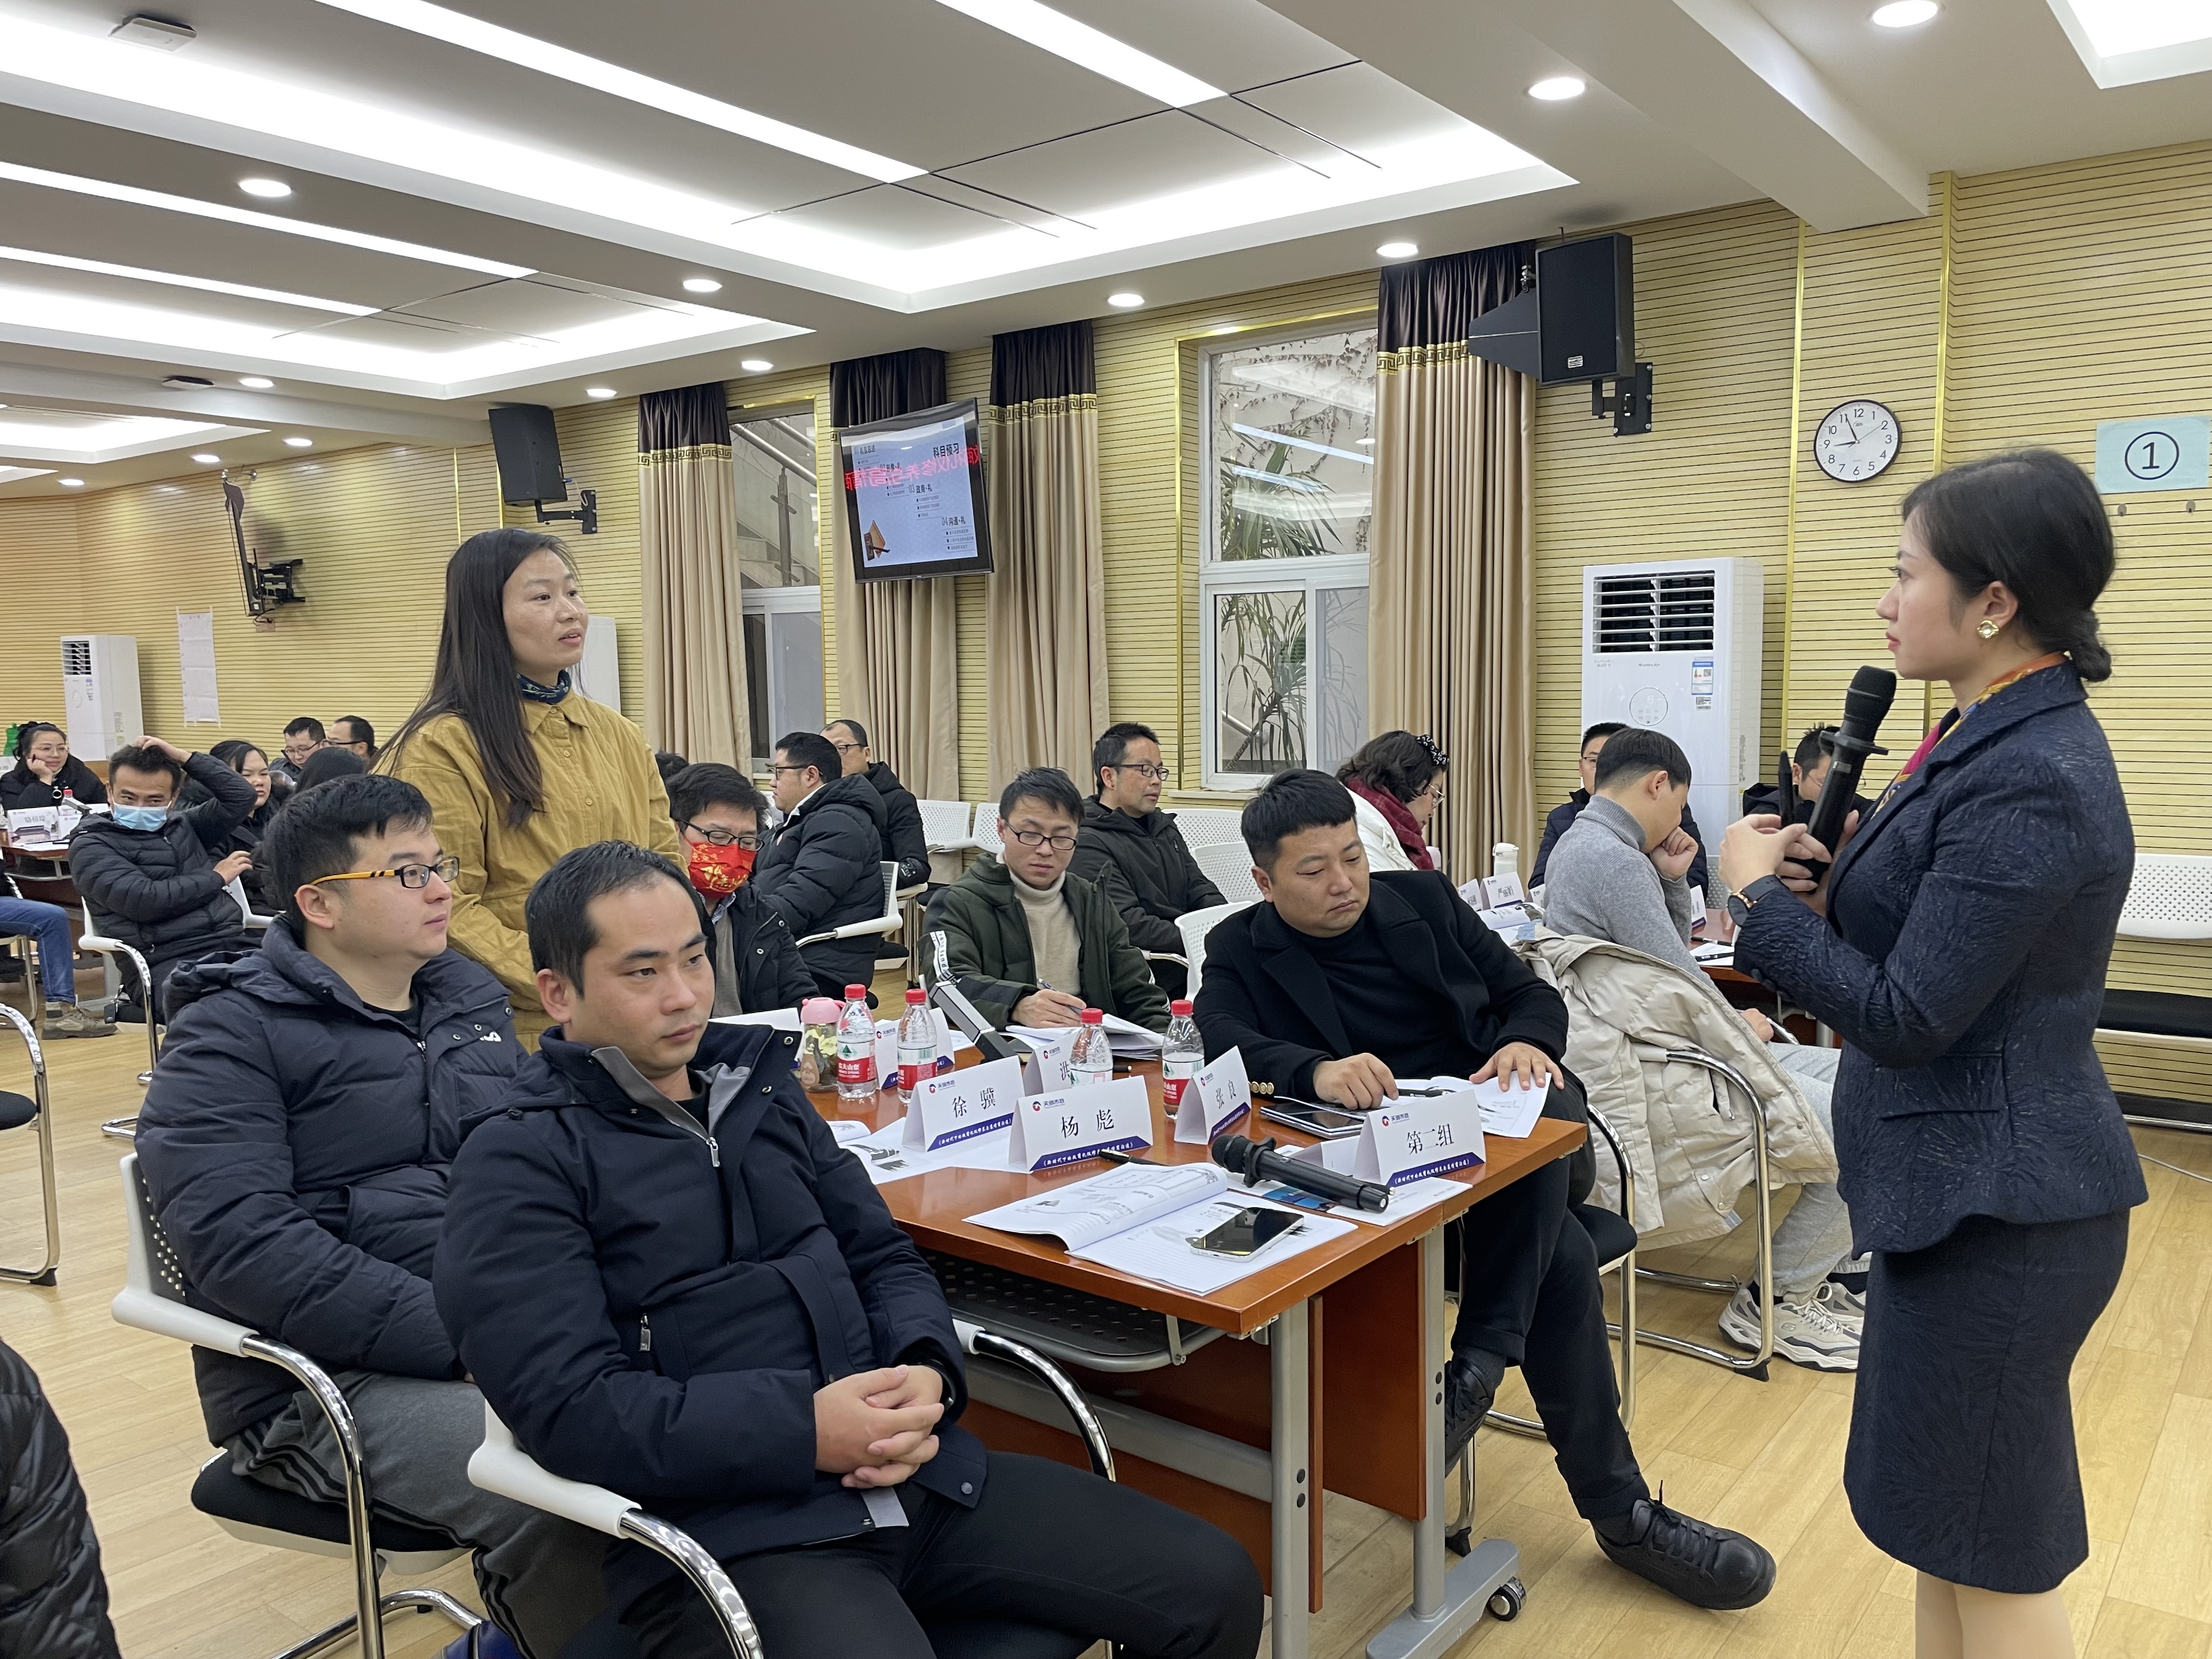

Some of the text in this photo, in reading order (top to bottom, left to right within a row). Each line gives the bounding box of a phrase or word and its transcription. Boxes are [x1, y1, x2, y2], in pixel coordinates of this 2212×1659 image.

[1854, 409, 1864, 417] 12
[1872, 411, 1875, 420] 1
[1840, 414, 1848, 423] 11
[1881, 420, 1888, 430] 2
[1828, 426, 1837, 435] 10
[1824, 439, 1830, 449] 9
[1885, 435, 1892, 444] 3
[933, 443, 959, 459] 科目预习
[1880, 450, 1886, 459] 4
[1829, 455, 1835, 464] 8
[1839, 464, 1845, 473] 7
[1868, 461, 1875, 470] 5
[1853, 466, 1859, 475] 6
[909, 484, 915, 493] 03
[1059, 1060, 1070, 1081] 洪
[1215, 1079, 1236, 1109] 张良
[1060, 1109, 1114, 1138] 杨彪
[1407, 1123, 1454, 1155] 第二组
